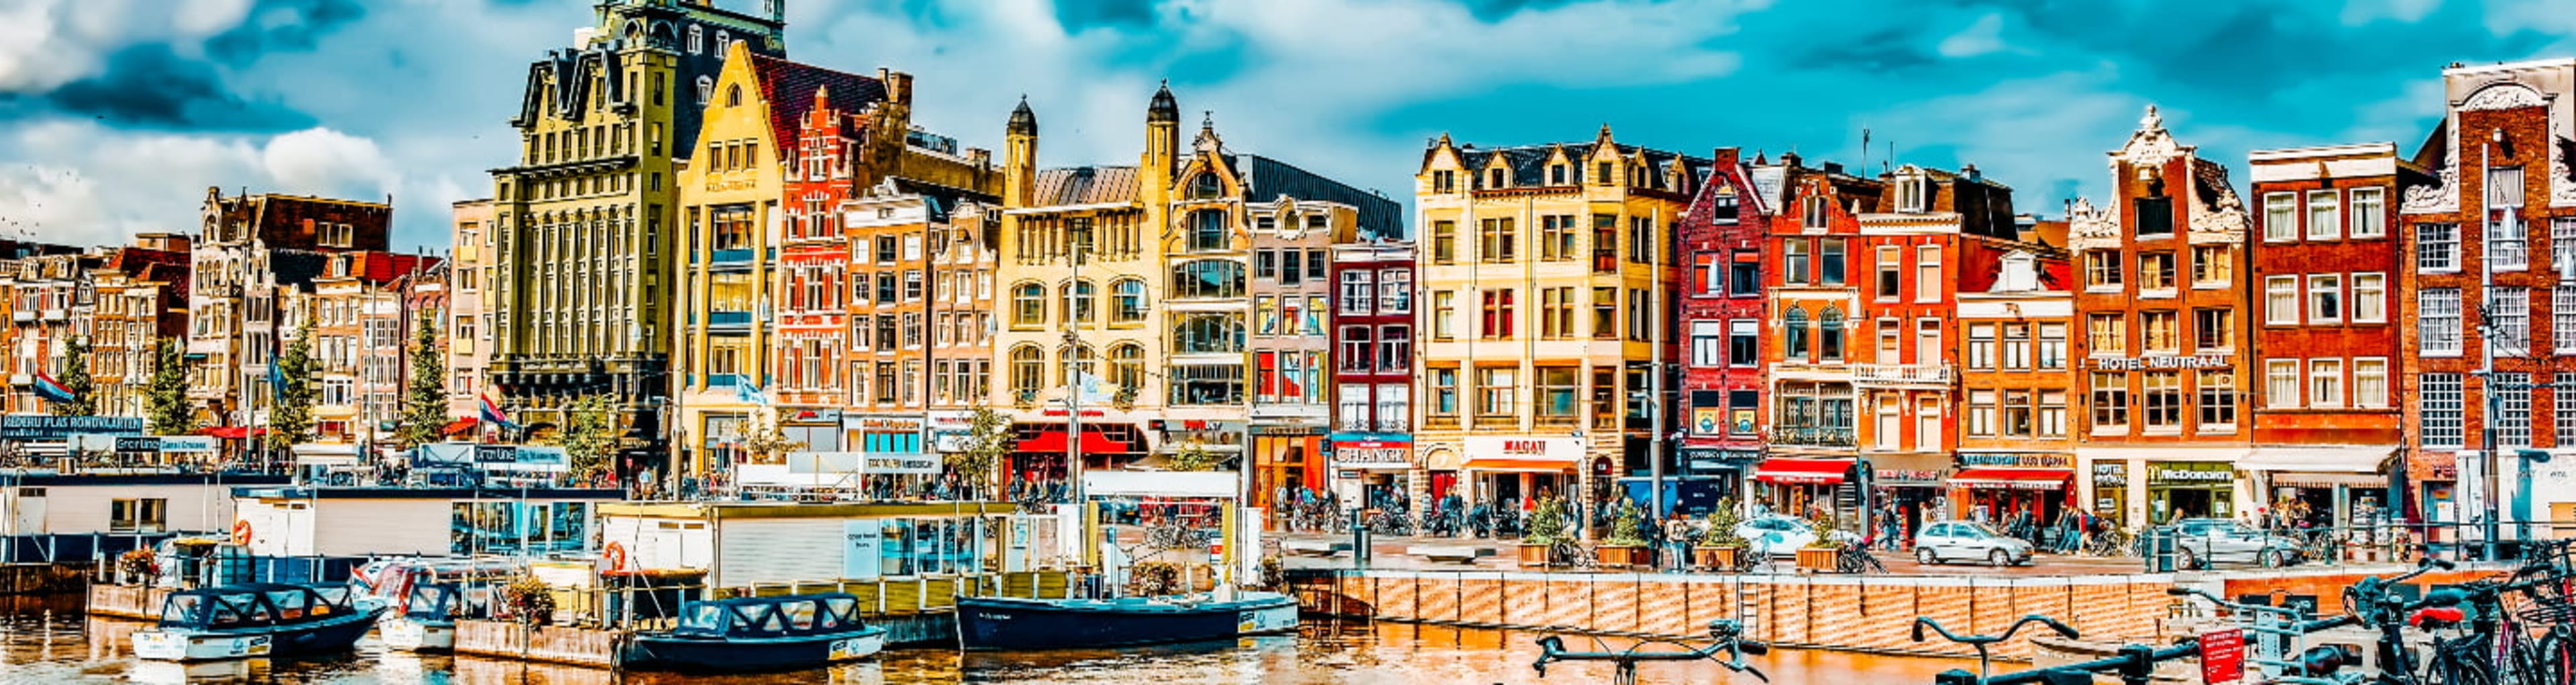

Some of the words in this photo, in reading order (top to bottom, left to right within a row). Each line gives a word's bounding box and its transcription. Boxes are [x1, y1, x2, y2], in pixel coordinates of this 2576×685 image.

[2098, 358, 2145, 370] HOTEL
[2149, 354, 2229, 368] NEUTRAAL
[44, 417, 67, 428] PLAS
[1504, 440, 1546, 452] MACAU
[1336, 449, 1406, 463] CHANGE
